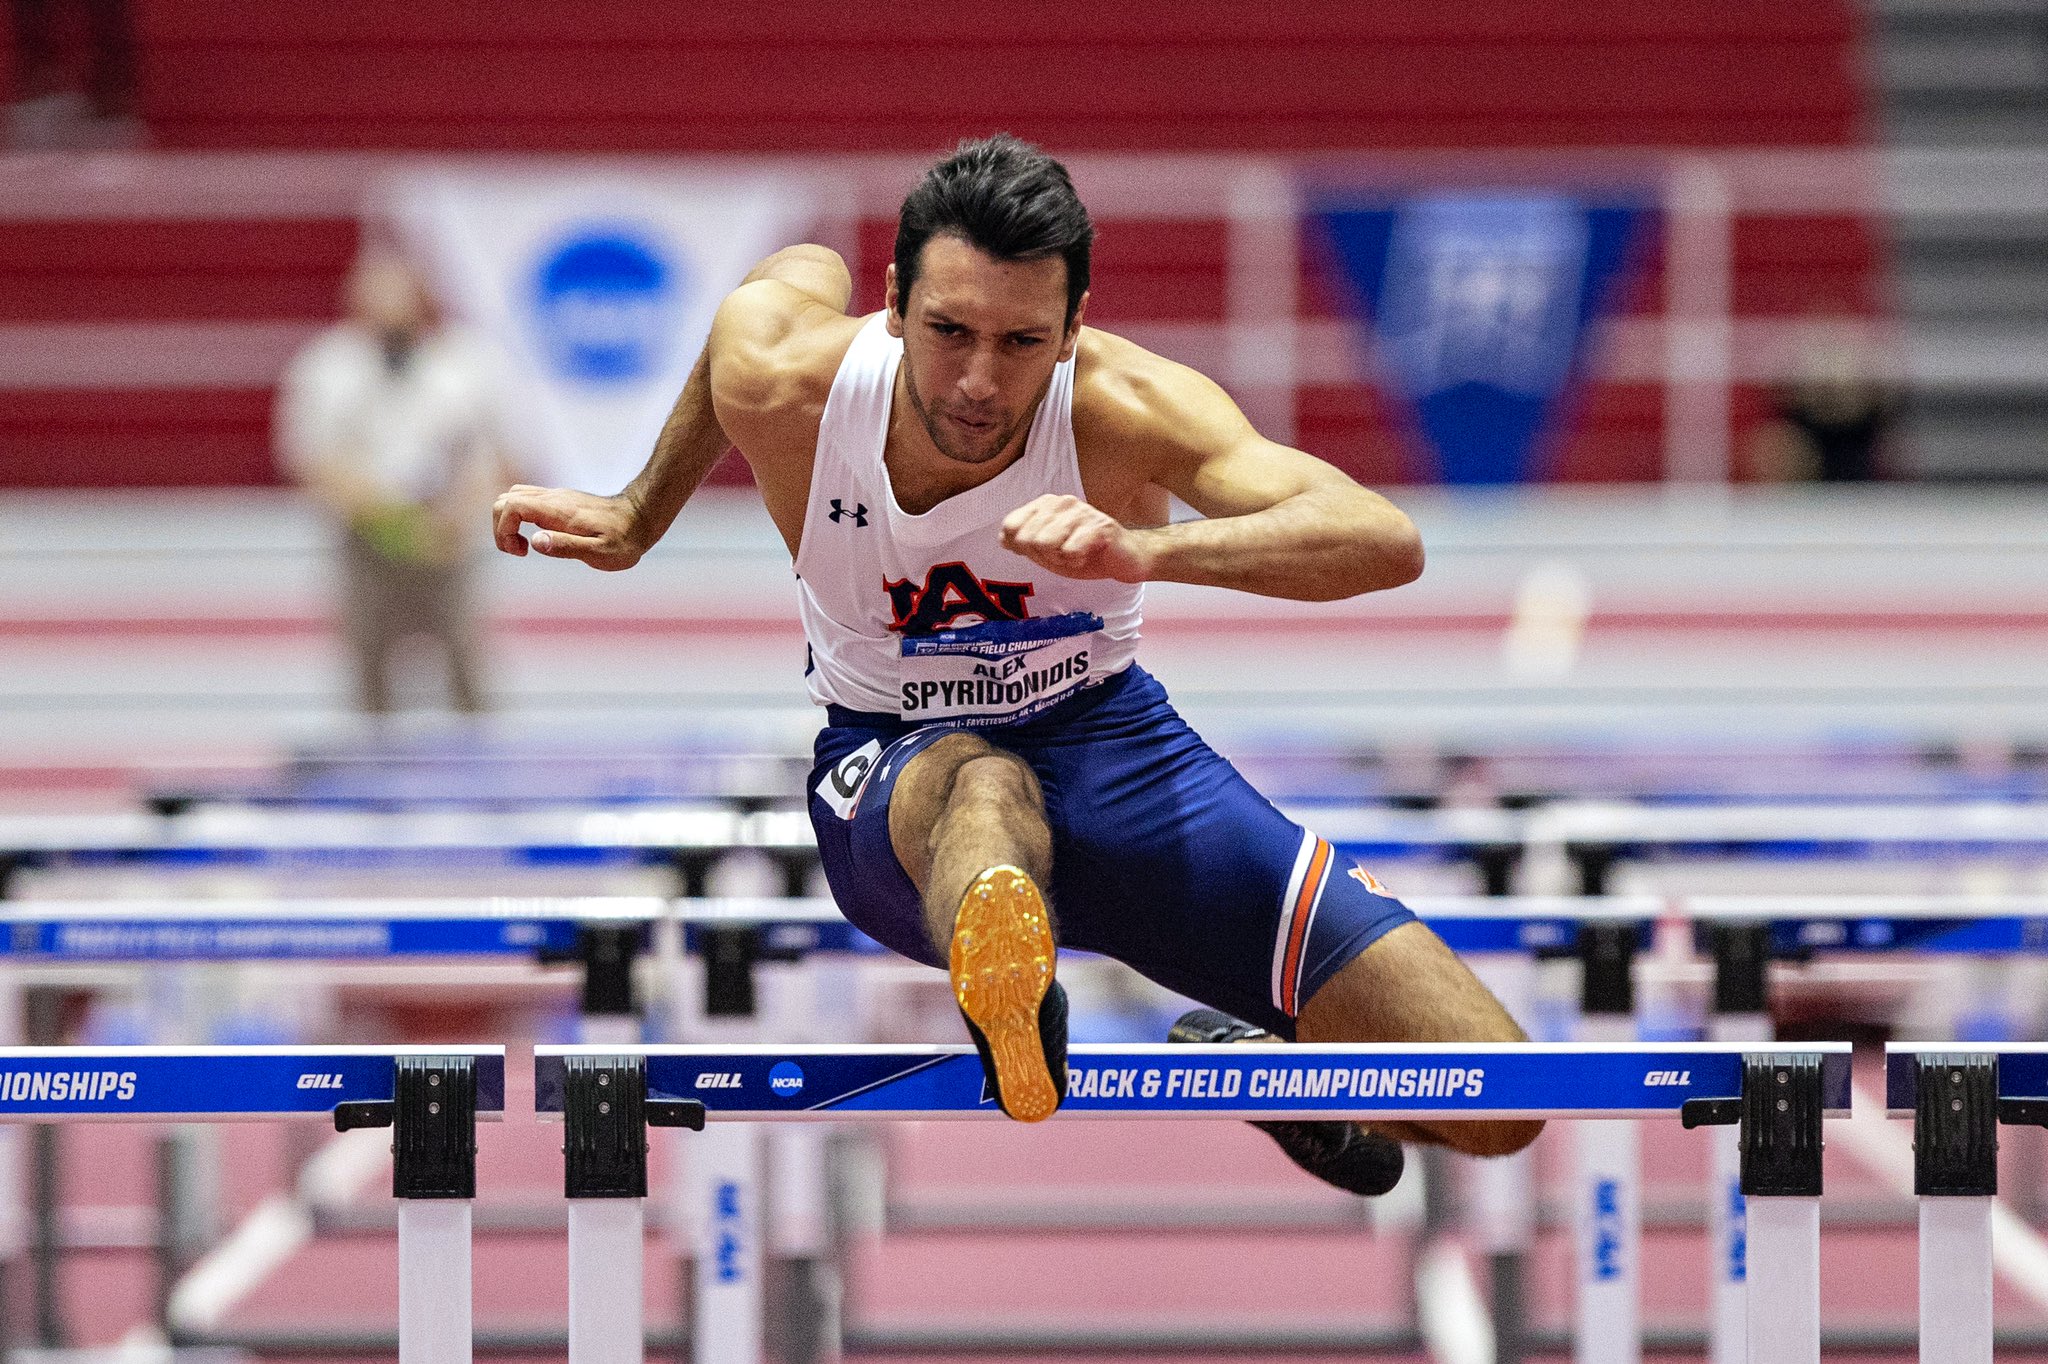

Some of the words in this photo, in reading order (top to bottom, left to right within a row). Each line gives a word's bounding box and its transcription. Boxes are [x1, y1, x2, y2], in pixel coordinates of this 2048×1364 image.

[979, 643, 1006, 654] FIELD
[973, 654, 1028, 680] ALEX
[901, 650, 1090, 711] SPYRIDONIDIS
[0, 1072, 137, 1101] IONSHIPS
[296, 1074, 343, 1089] GILL
[695, 1073, 743, 1089] GILL
[772, 1077, 804, 1088] NCAA
[1066, 1069, 1139, 1098] RACK
[1140, 1069, 1162, 1098] &
[1165, 1069, 1243, 1098] FIELD
[1248, 1068, 1485, 1098] CHAMPIONSHIPS
[1643, 1070, 1692, 1087] GILL
